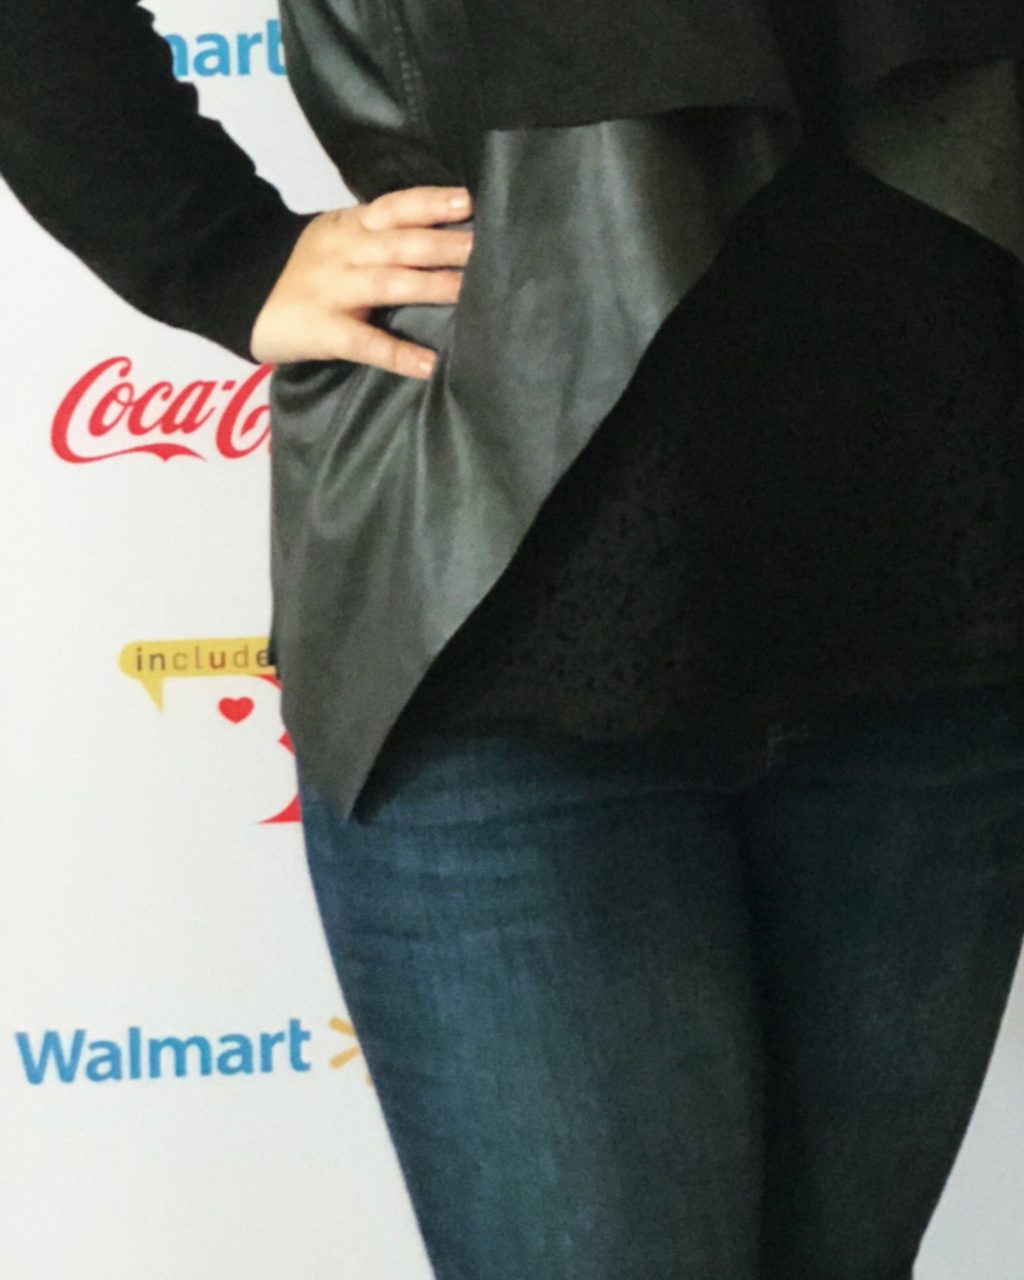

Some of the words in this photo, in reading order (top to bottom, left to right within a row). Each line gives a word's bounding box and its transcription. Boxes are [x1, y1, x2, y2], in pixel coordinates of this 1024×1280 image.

[50, 356, 275, 464] Coca-C
[136, 645, 269, 672] include
[15, 1019, 312, 1085] Walmart
